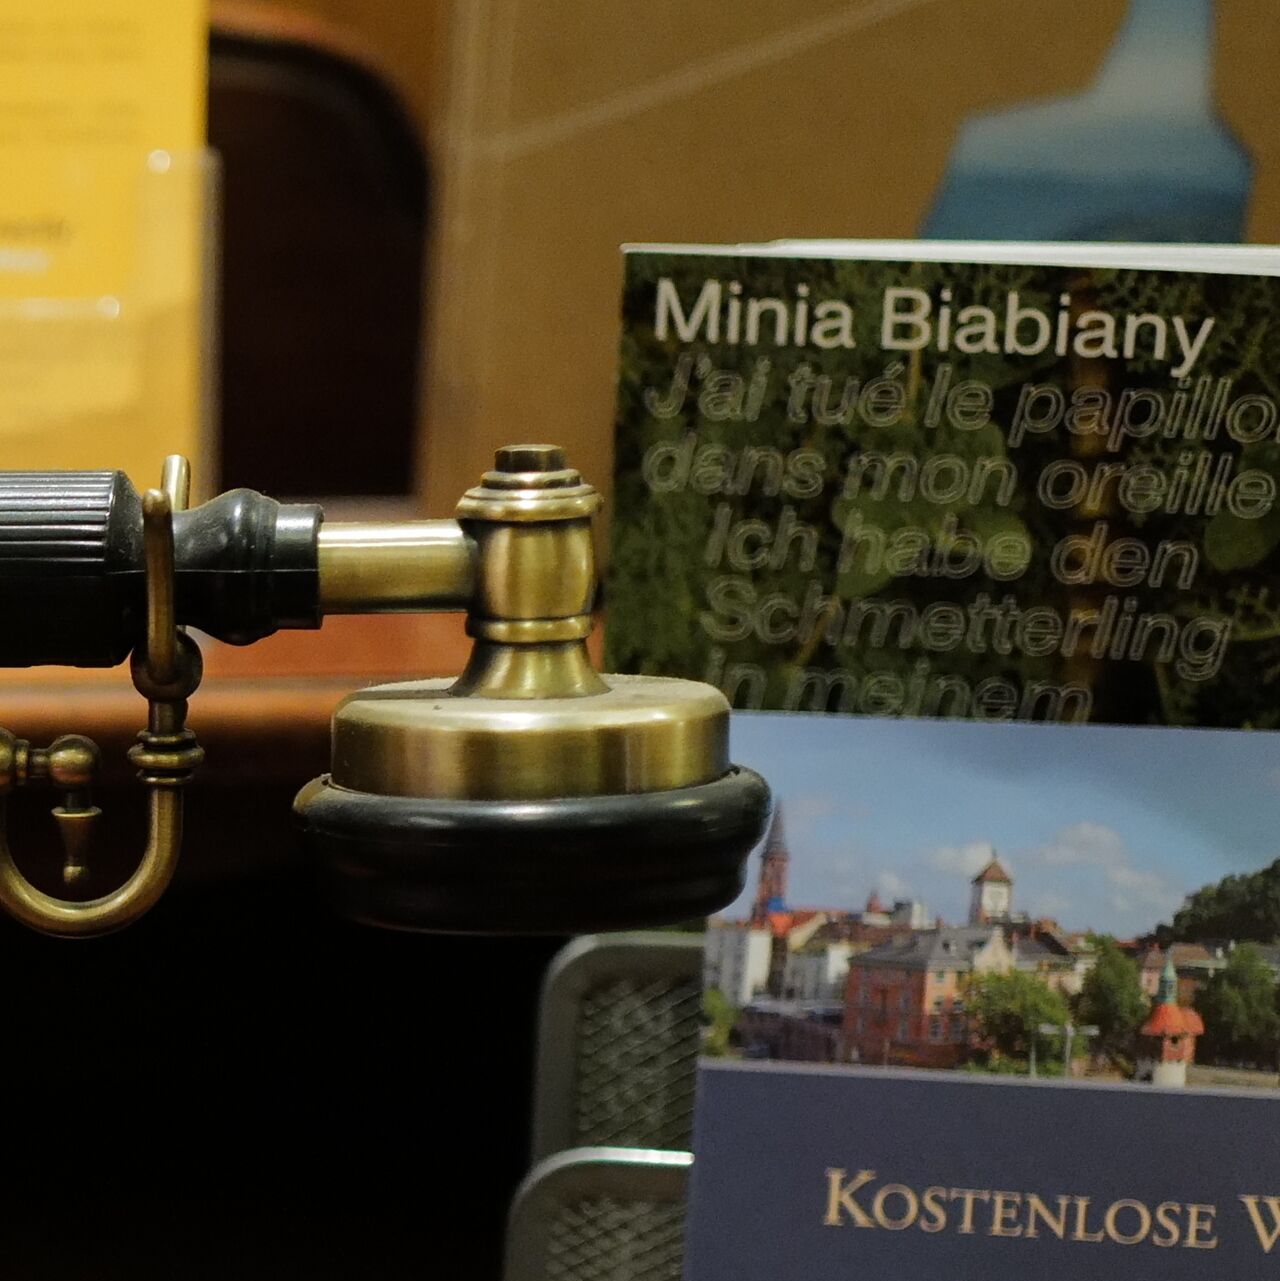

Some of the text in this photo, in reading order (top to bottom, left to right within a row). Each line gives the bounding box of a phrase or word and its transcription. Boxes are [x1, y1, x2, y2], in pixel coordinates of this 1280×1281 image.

[654, 277, 1216, 379] Minia Biabiany
[786, 360, 908, 428] tué
[923, 361, 995, 431] le
[1008, 373, 1280, 452] papillo
[641, 429, 1278, 520] dans mon oreille
[703, 503, 1200, 590] Ich habe den
[699, 575, 1234, 683] Schmetterling
[703, 646, 1094, 724] in meinem
